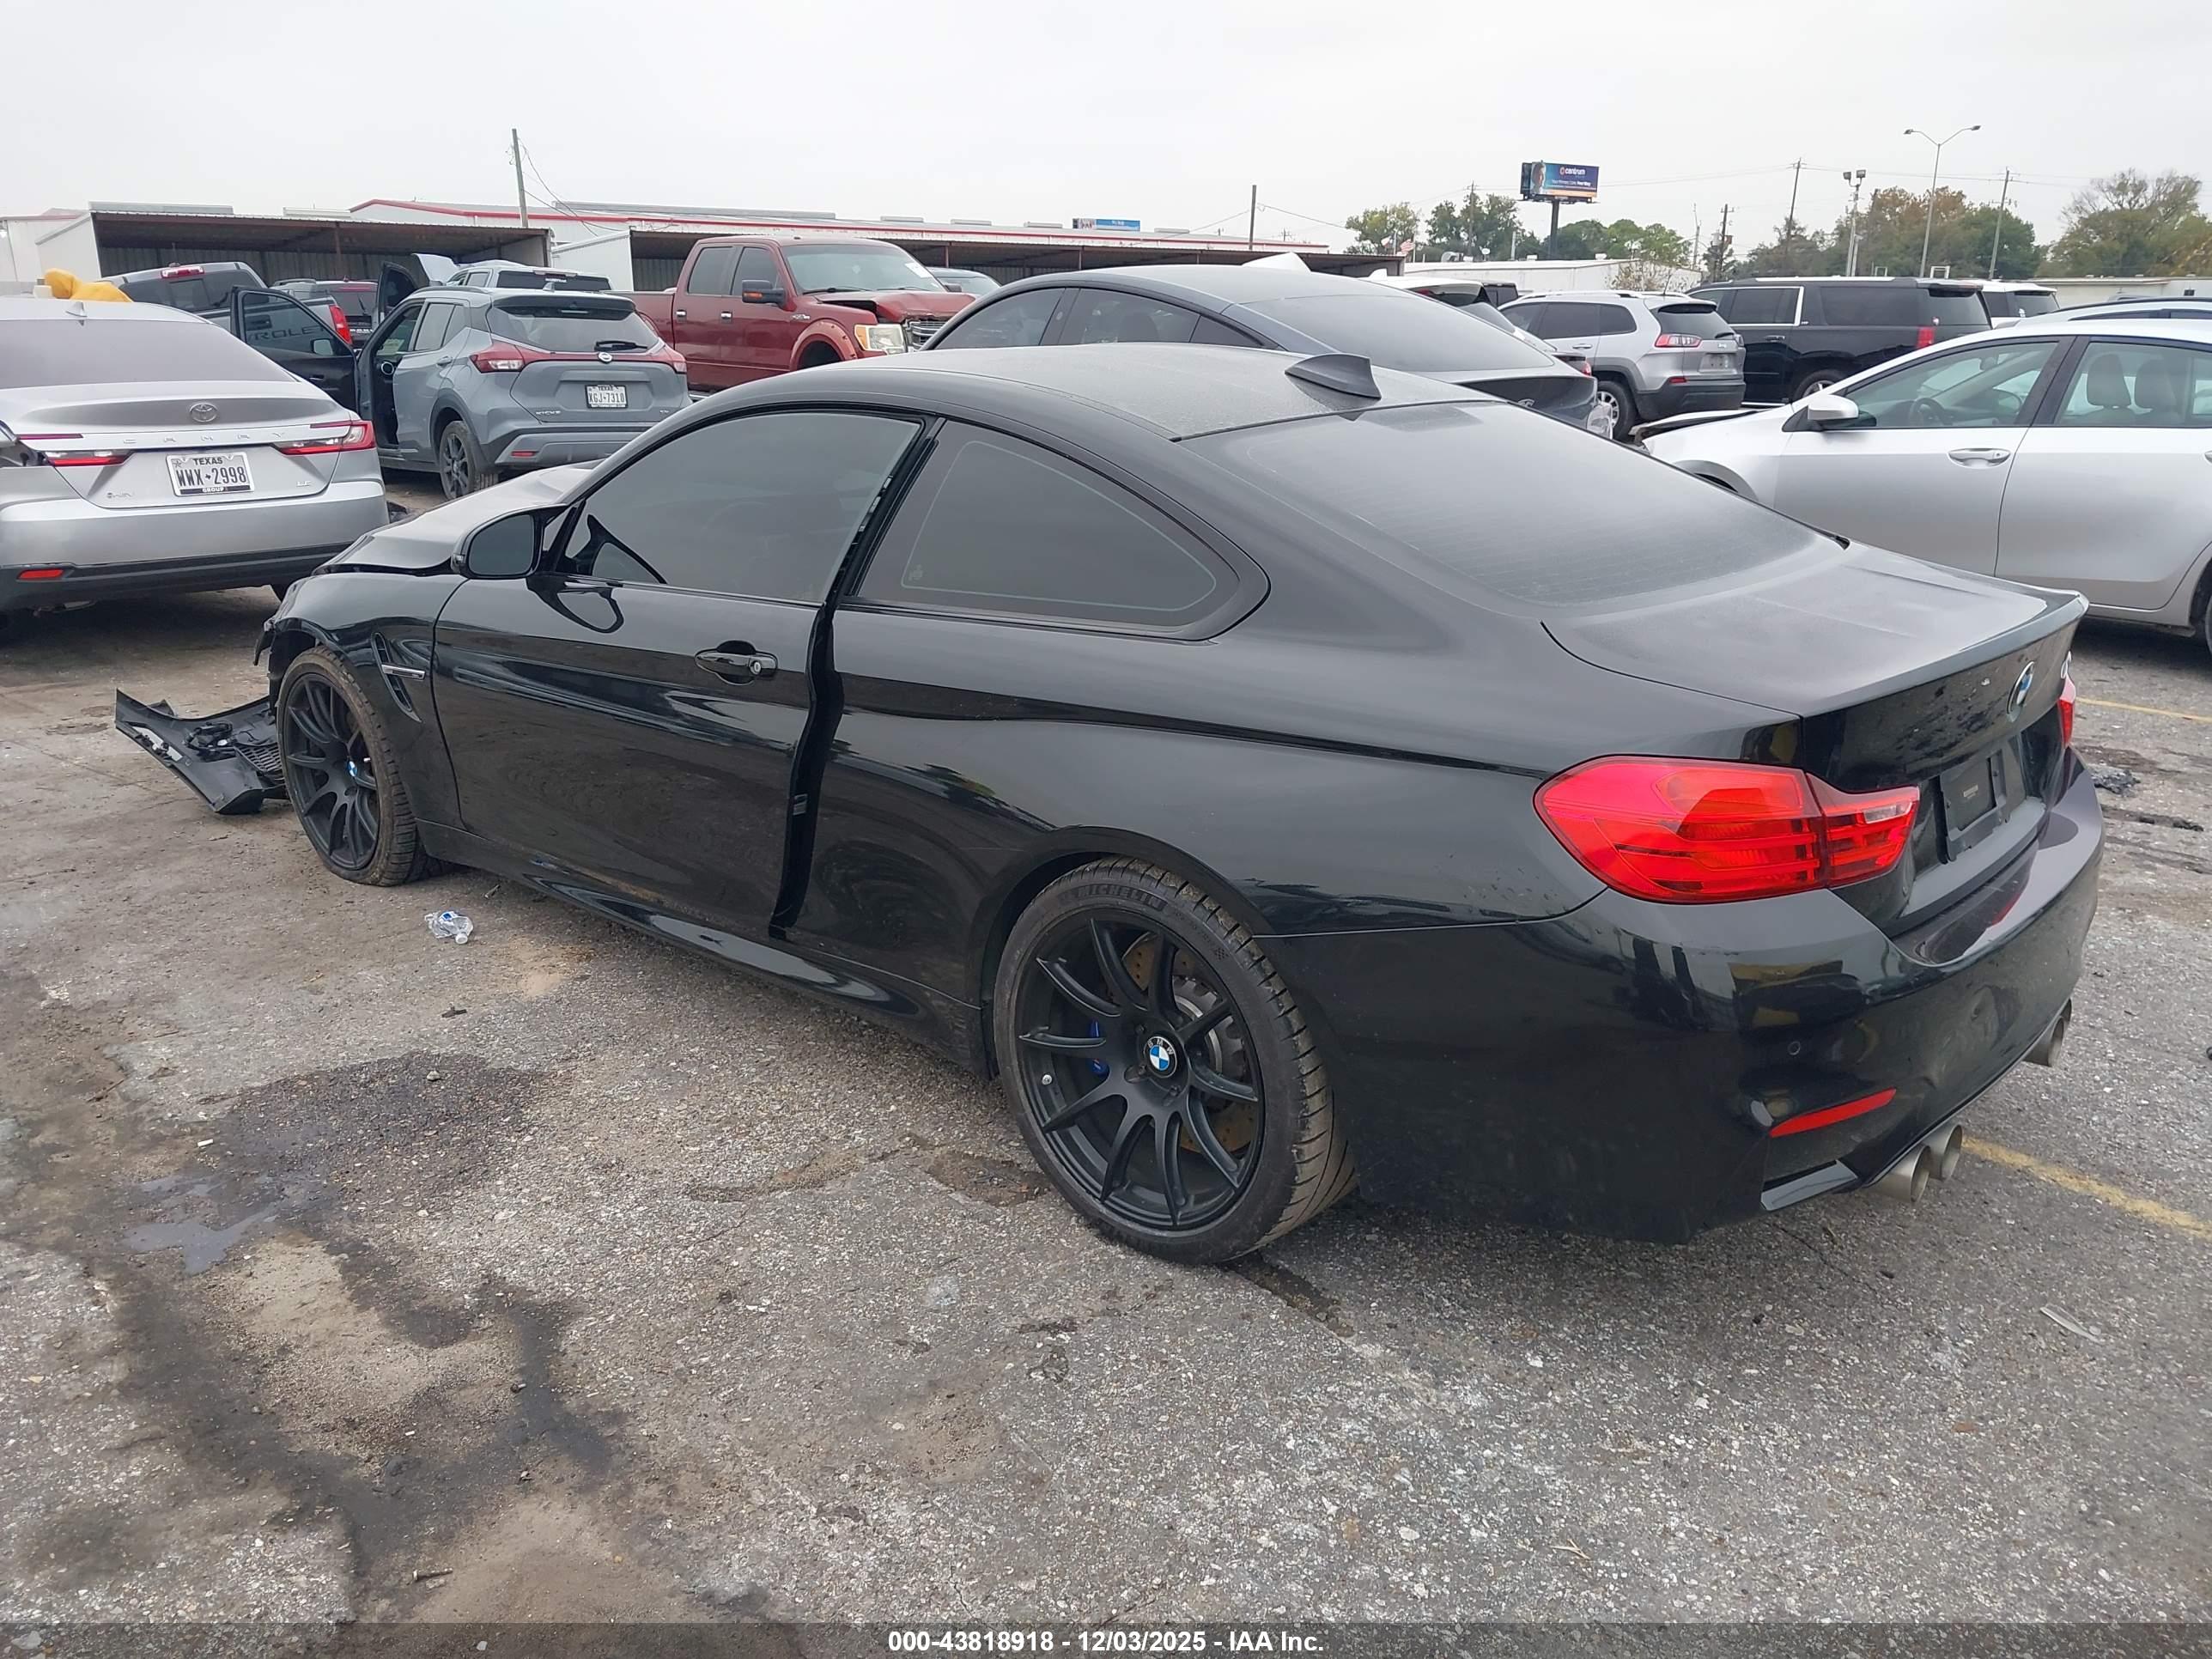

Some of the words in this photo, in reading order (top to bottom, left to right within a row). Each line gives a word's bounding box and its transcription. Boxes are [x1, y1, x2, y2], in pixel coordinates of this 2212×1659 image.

[192, 457, 223, 465] TEXAS
[1078, 884, 1165, 911] MICHELIN
[1147, 1038, 1174, 1054] BMW
